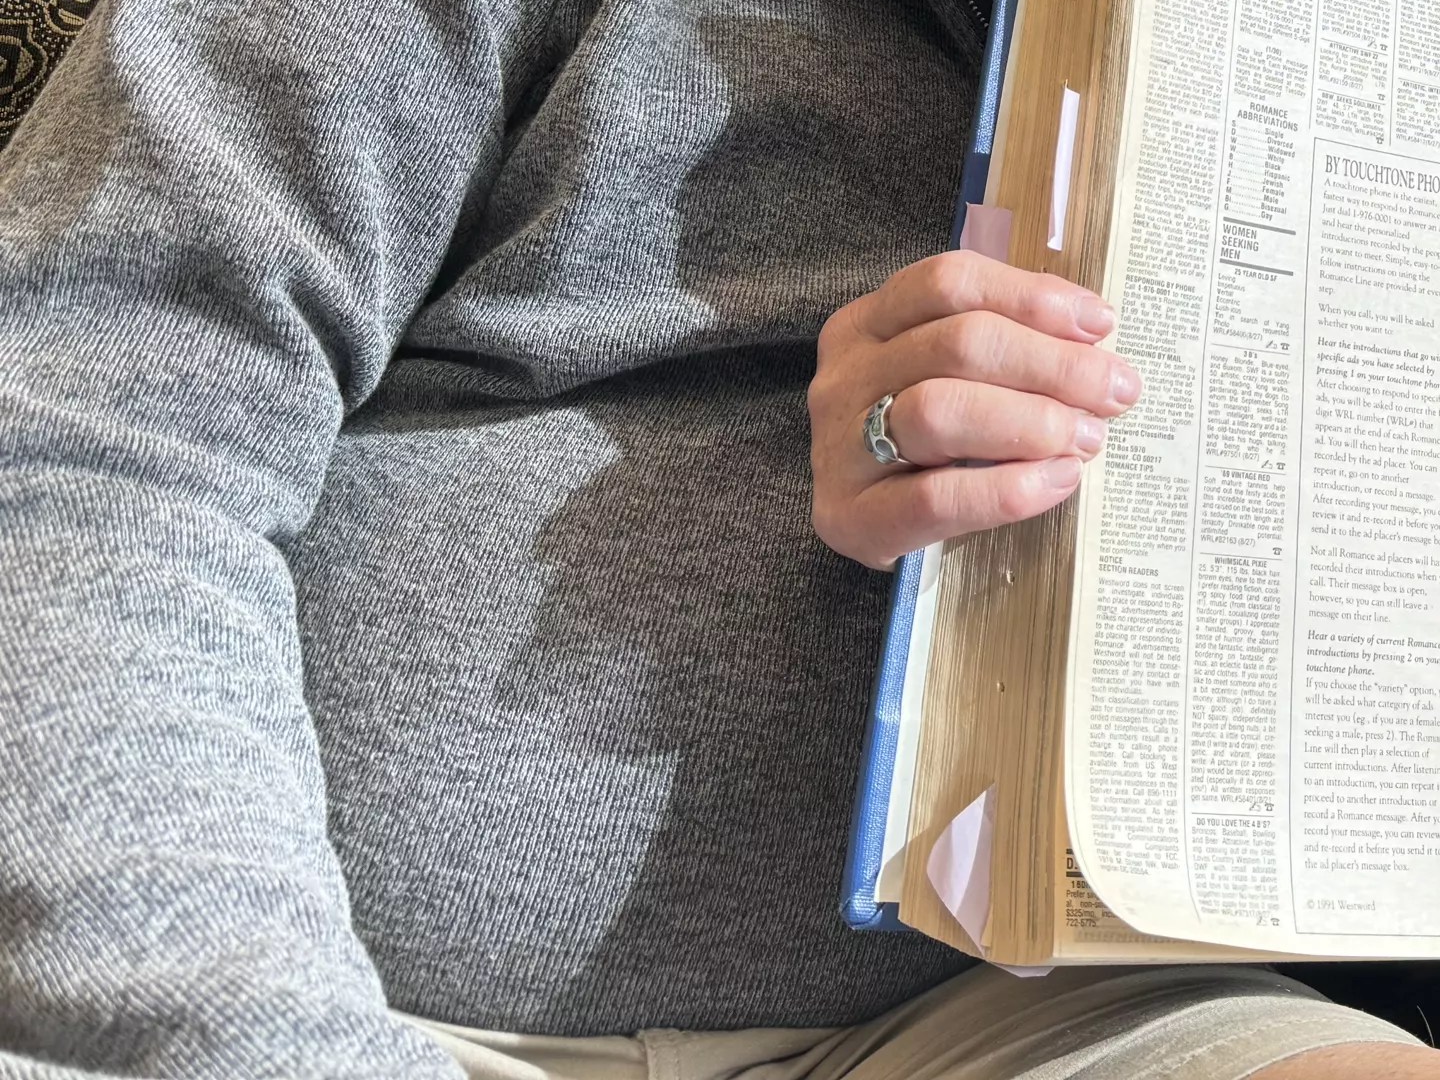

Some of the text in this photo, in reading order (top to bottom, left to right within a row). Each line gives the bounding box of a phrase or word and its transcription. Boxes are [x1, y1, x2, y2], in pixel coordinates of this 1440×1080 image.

[1250, 102, 1288, 119] ROMANCE
[1238, 110, 1298, 132] ABBREVIATIONS
[1325, 155, 1340, 174] BY
[1342, 159, 1414, 188] TOUCHTONE
[1223, 224, 1257, 240] WOMEN
[1222, 236, 1259, 252] SEEKING
[1317, 336, 1336, 346] Hear
[1353, 342, 1401, 355] introductions
[1403, 349, 1418, 358] that
[1307, 629, 1328, 639] Hear
[1337, 633, 1364, 644] variety
[1407, 637, 1440, 648] Romance
[1337, 900, 1375, 910] Westword
